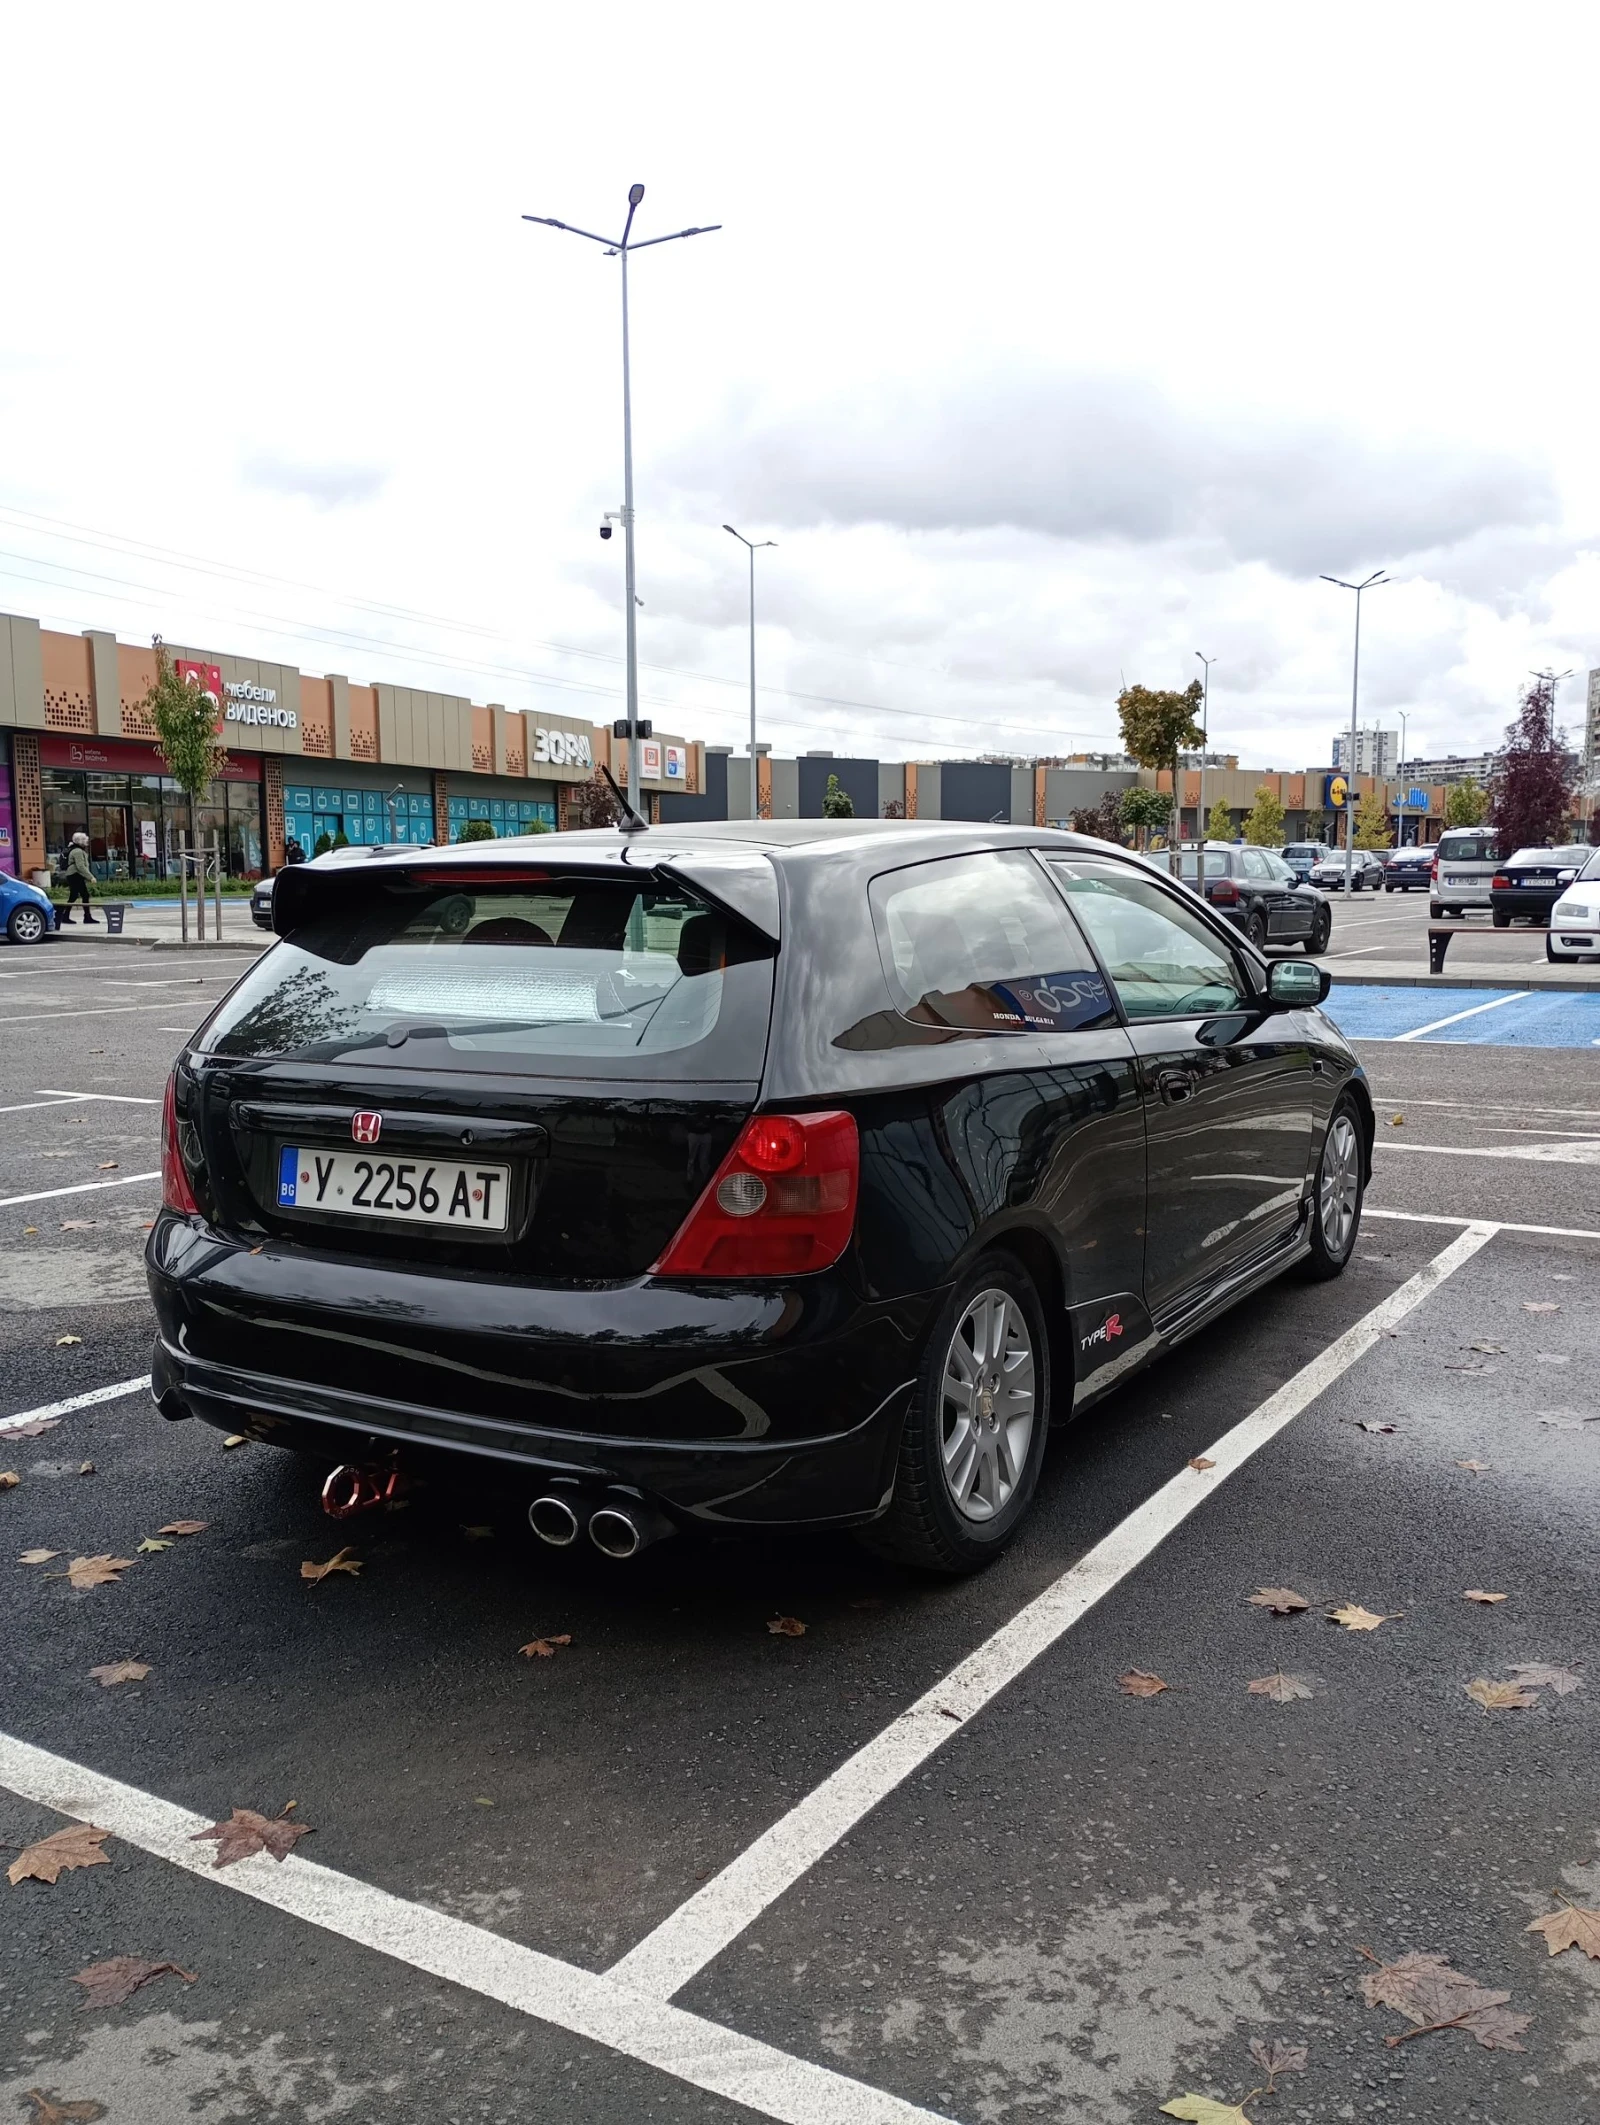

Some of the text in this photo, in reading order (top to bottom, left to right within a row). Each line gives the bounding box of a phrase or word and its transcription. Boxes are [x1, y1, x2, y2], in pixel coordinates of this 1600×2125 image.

[224, 680, 277, 703] мебели
[533, 727, 592, 768] ЗОРА
[993, 1012, 1021, 1021] HONDA
[1024, 1015, 1055, 1025] BULGARIA
[281, 1182, 295, 1197] BG
[352, 1161, 440, 1214] 2256
[448, 1170, 501, 1220] AT
